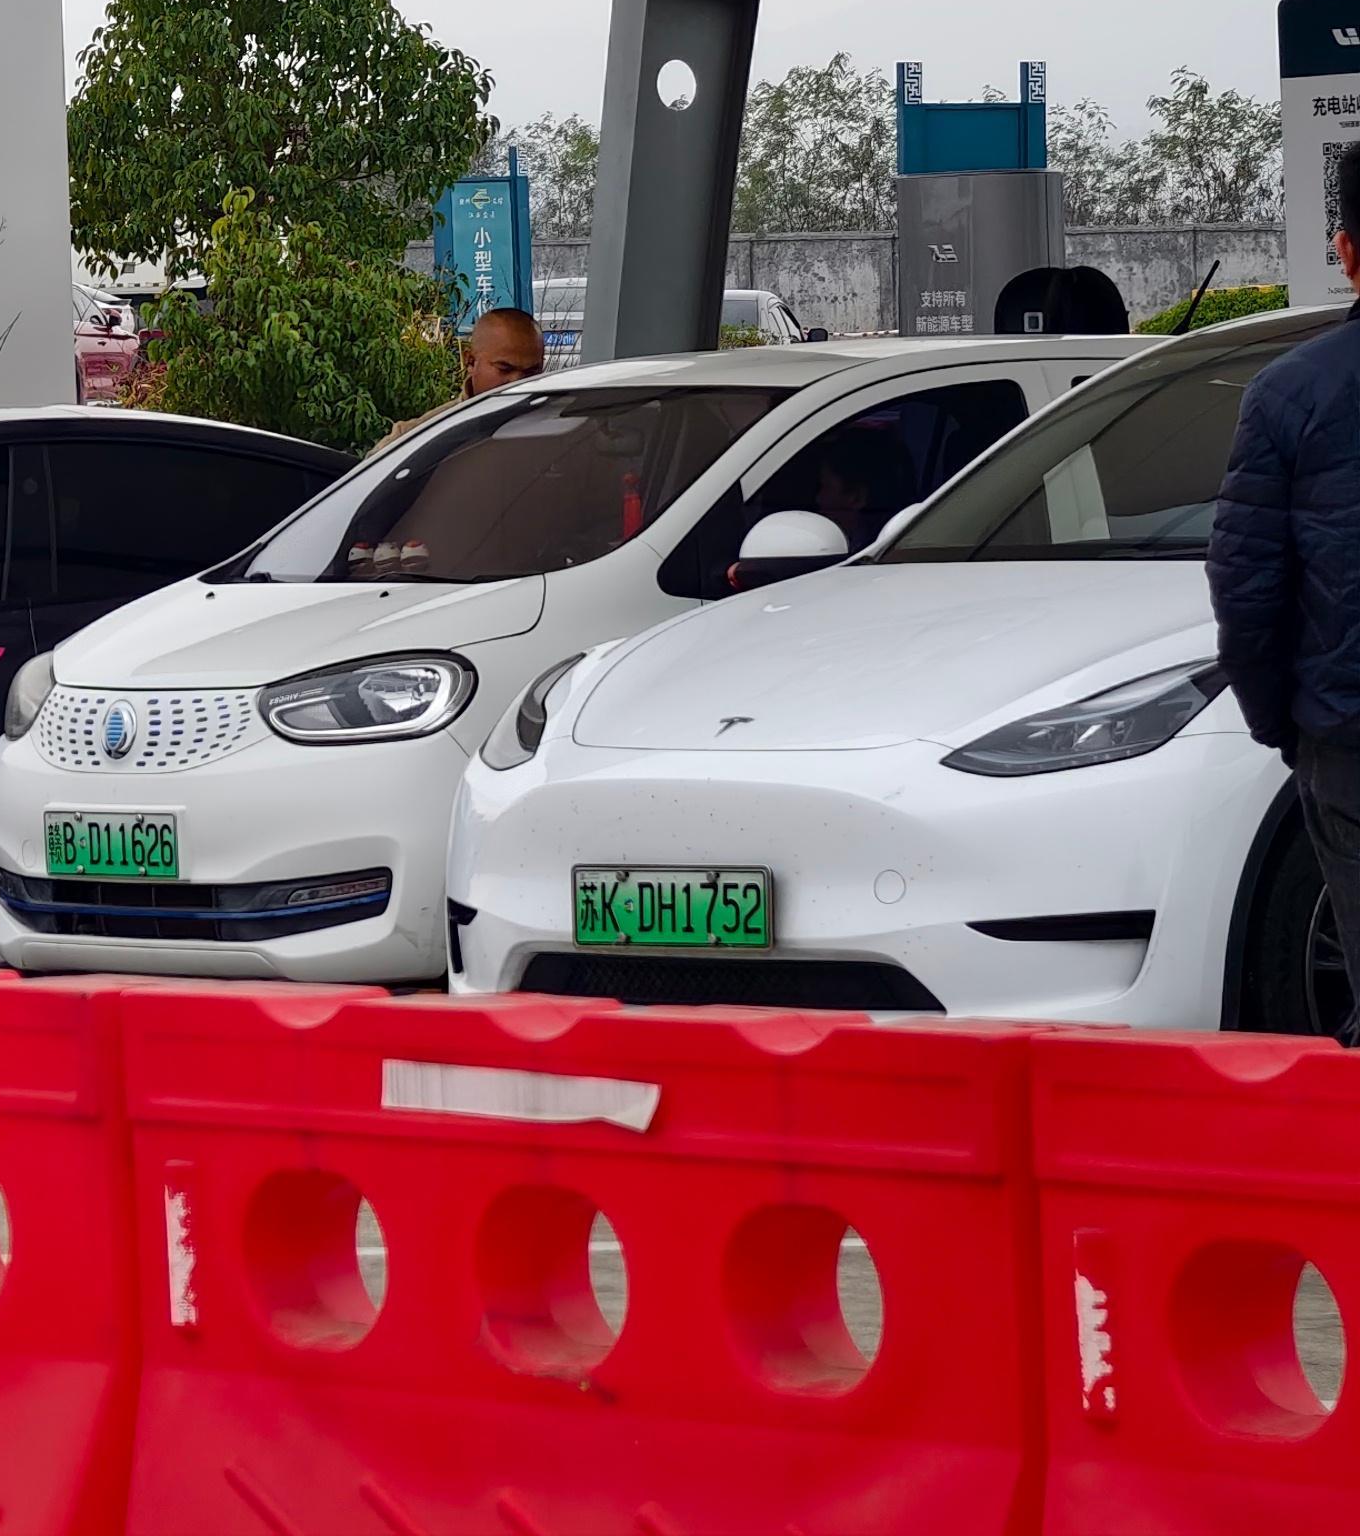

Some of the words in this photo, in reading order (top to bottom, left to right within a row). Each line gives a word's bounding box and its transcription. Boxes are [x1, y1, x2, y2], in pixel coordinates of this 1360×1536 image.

[920, 290, 967, 308] 支持所有
[915, 314, 974, 333] 新能源车型
